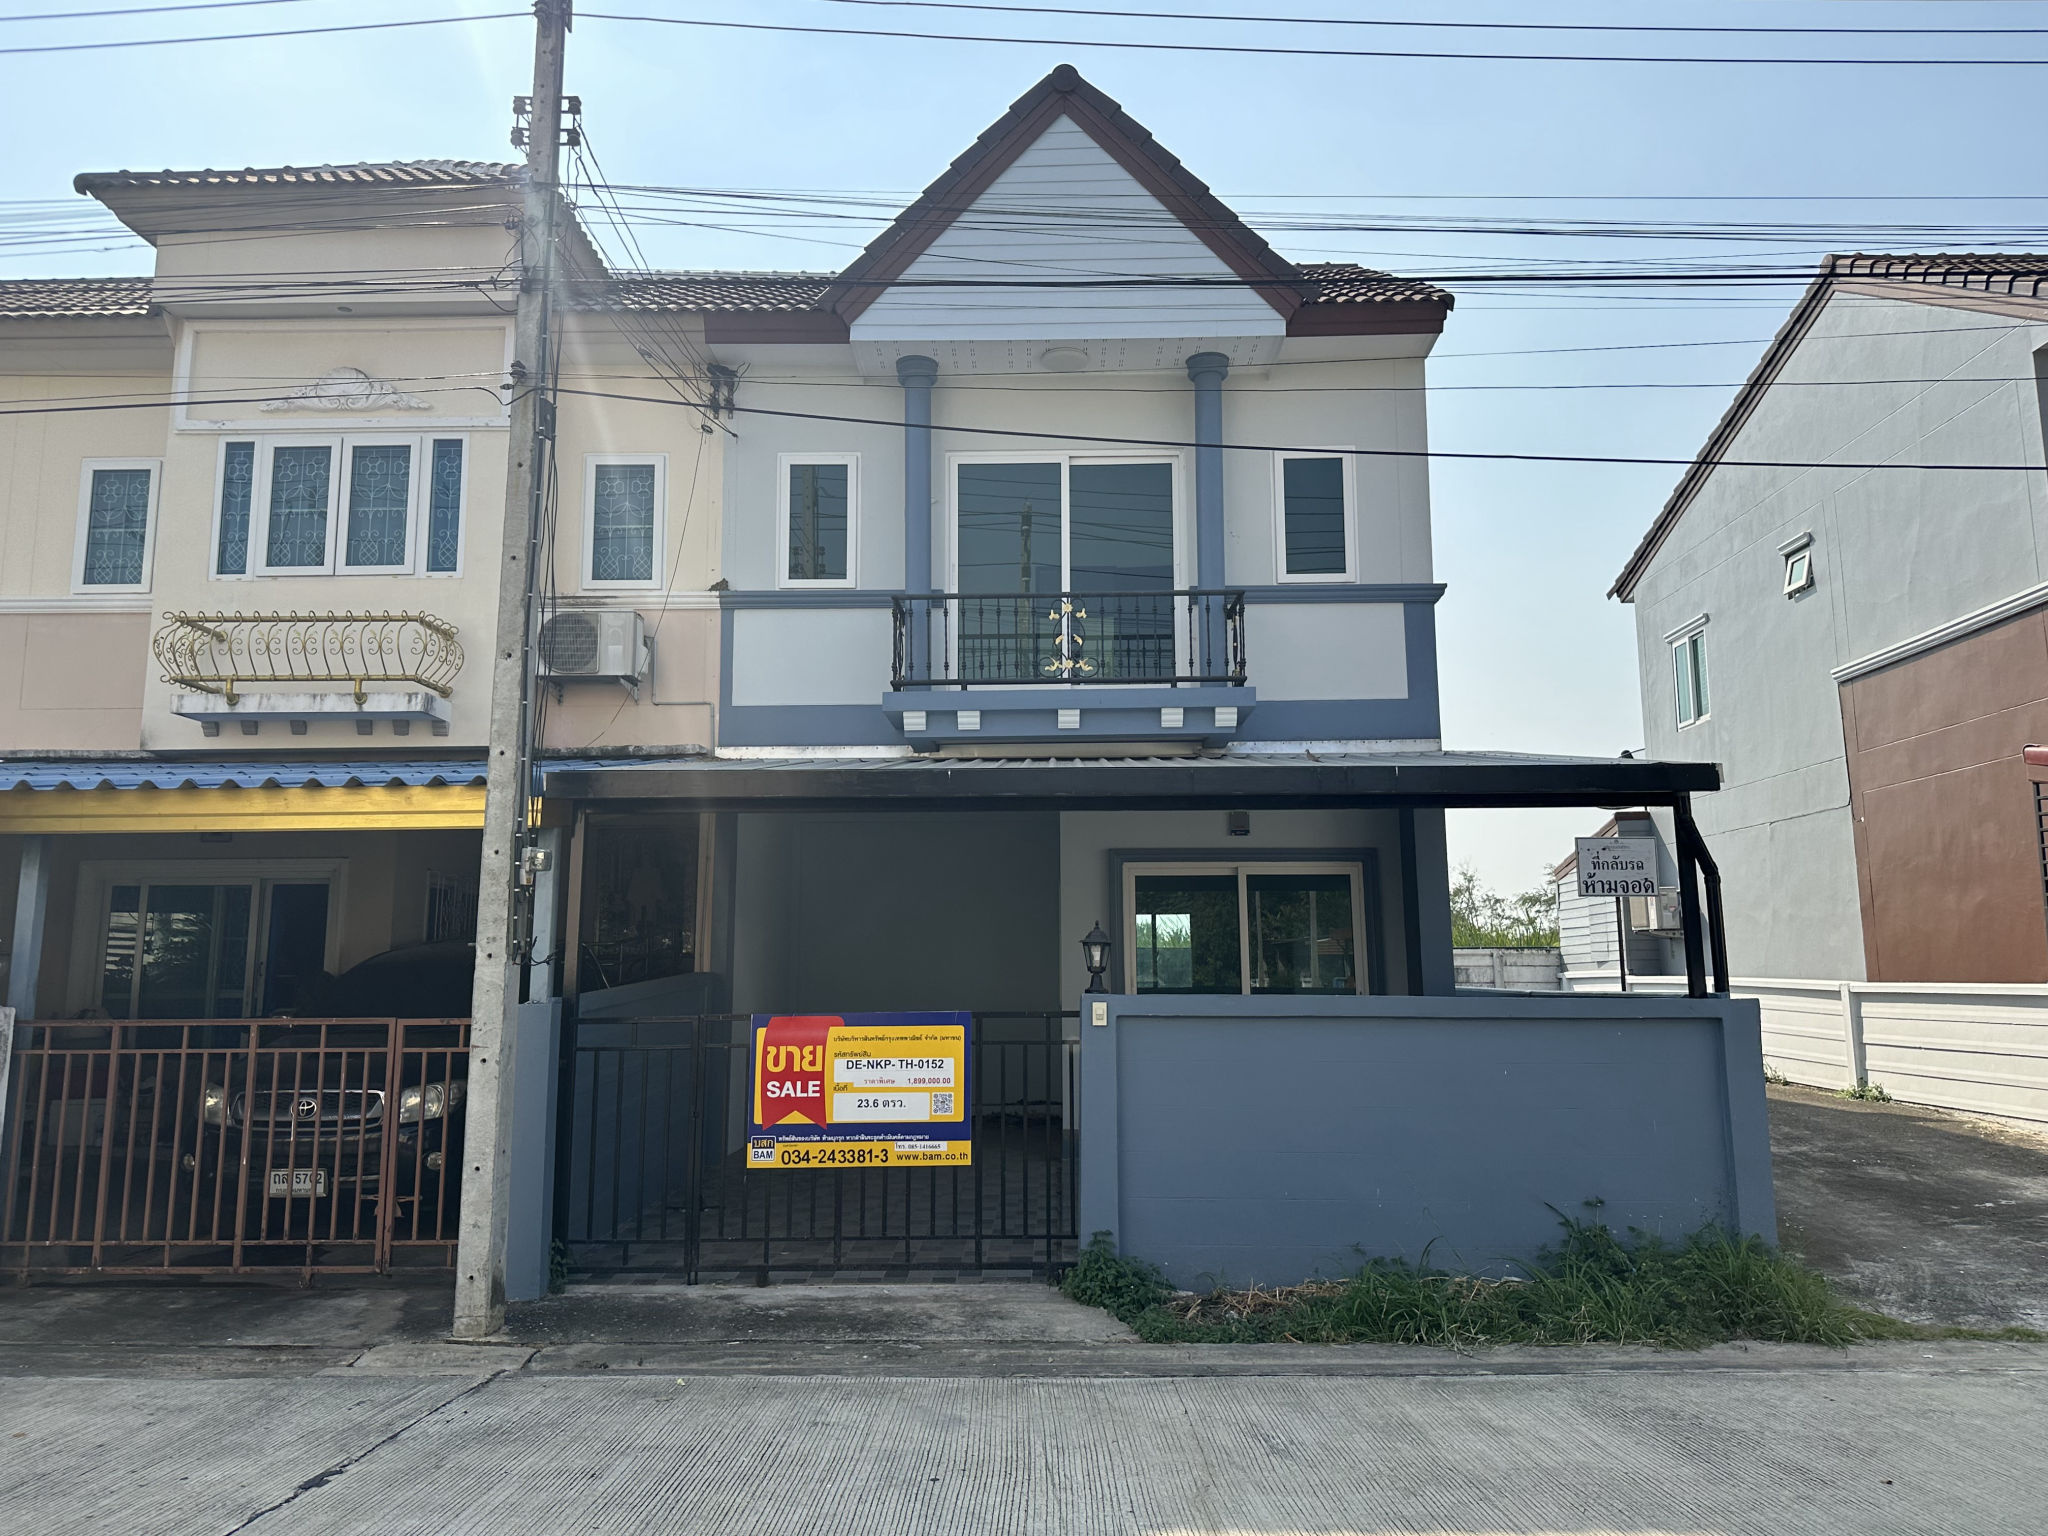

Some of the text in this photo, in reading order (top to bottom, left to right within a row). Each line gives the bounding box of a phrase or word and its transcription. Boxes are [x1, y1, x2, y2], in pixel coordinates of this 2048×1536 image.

[1591, 851, 1644, 870] ที่กลับรถ
[1582, 872, 1654, 894] ห้ามจอด
[766, 1045, 823, 1073] ขาย
[898, 1059, 944, 1069] TH-0152
[907, 1077, 951, 1085] 1,899,000.00
[766, 1081, 821, 1098] SALE
[857, 1098, 906, 1108] 23.6 ตรว.
[753, 1138, 774, 1148] บสก
[753, 1150, 773, 1159] BAM
[781, 1149, 889, 1166] 034-243381-3
[896, 1152, 968, 1161] www.bam.co.th
